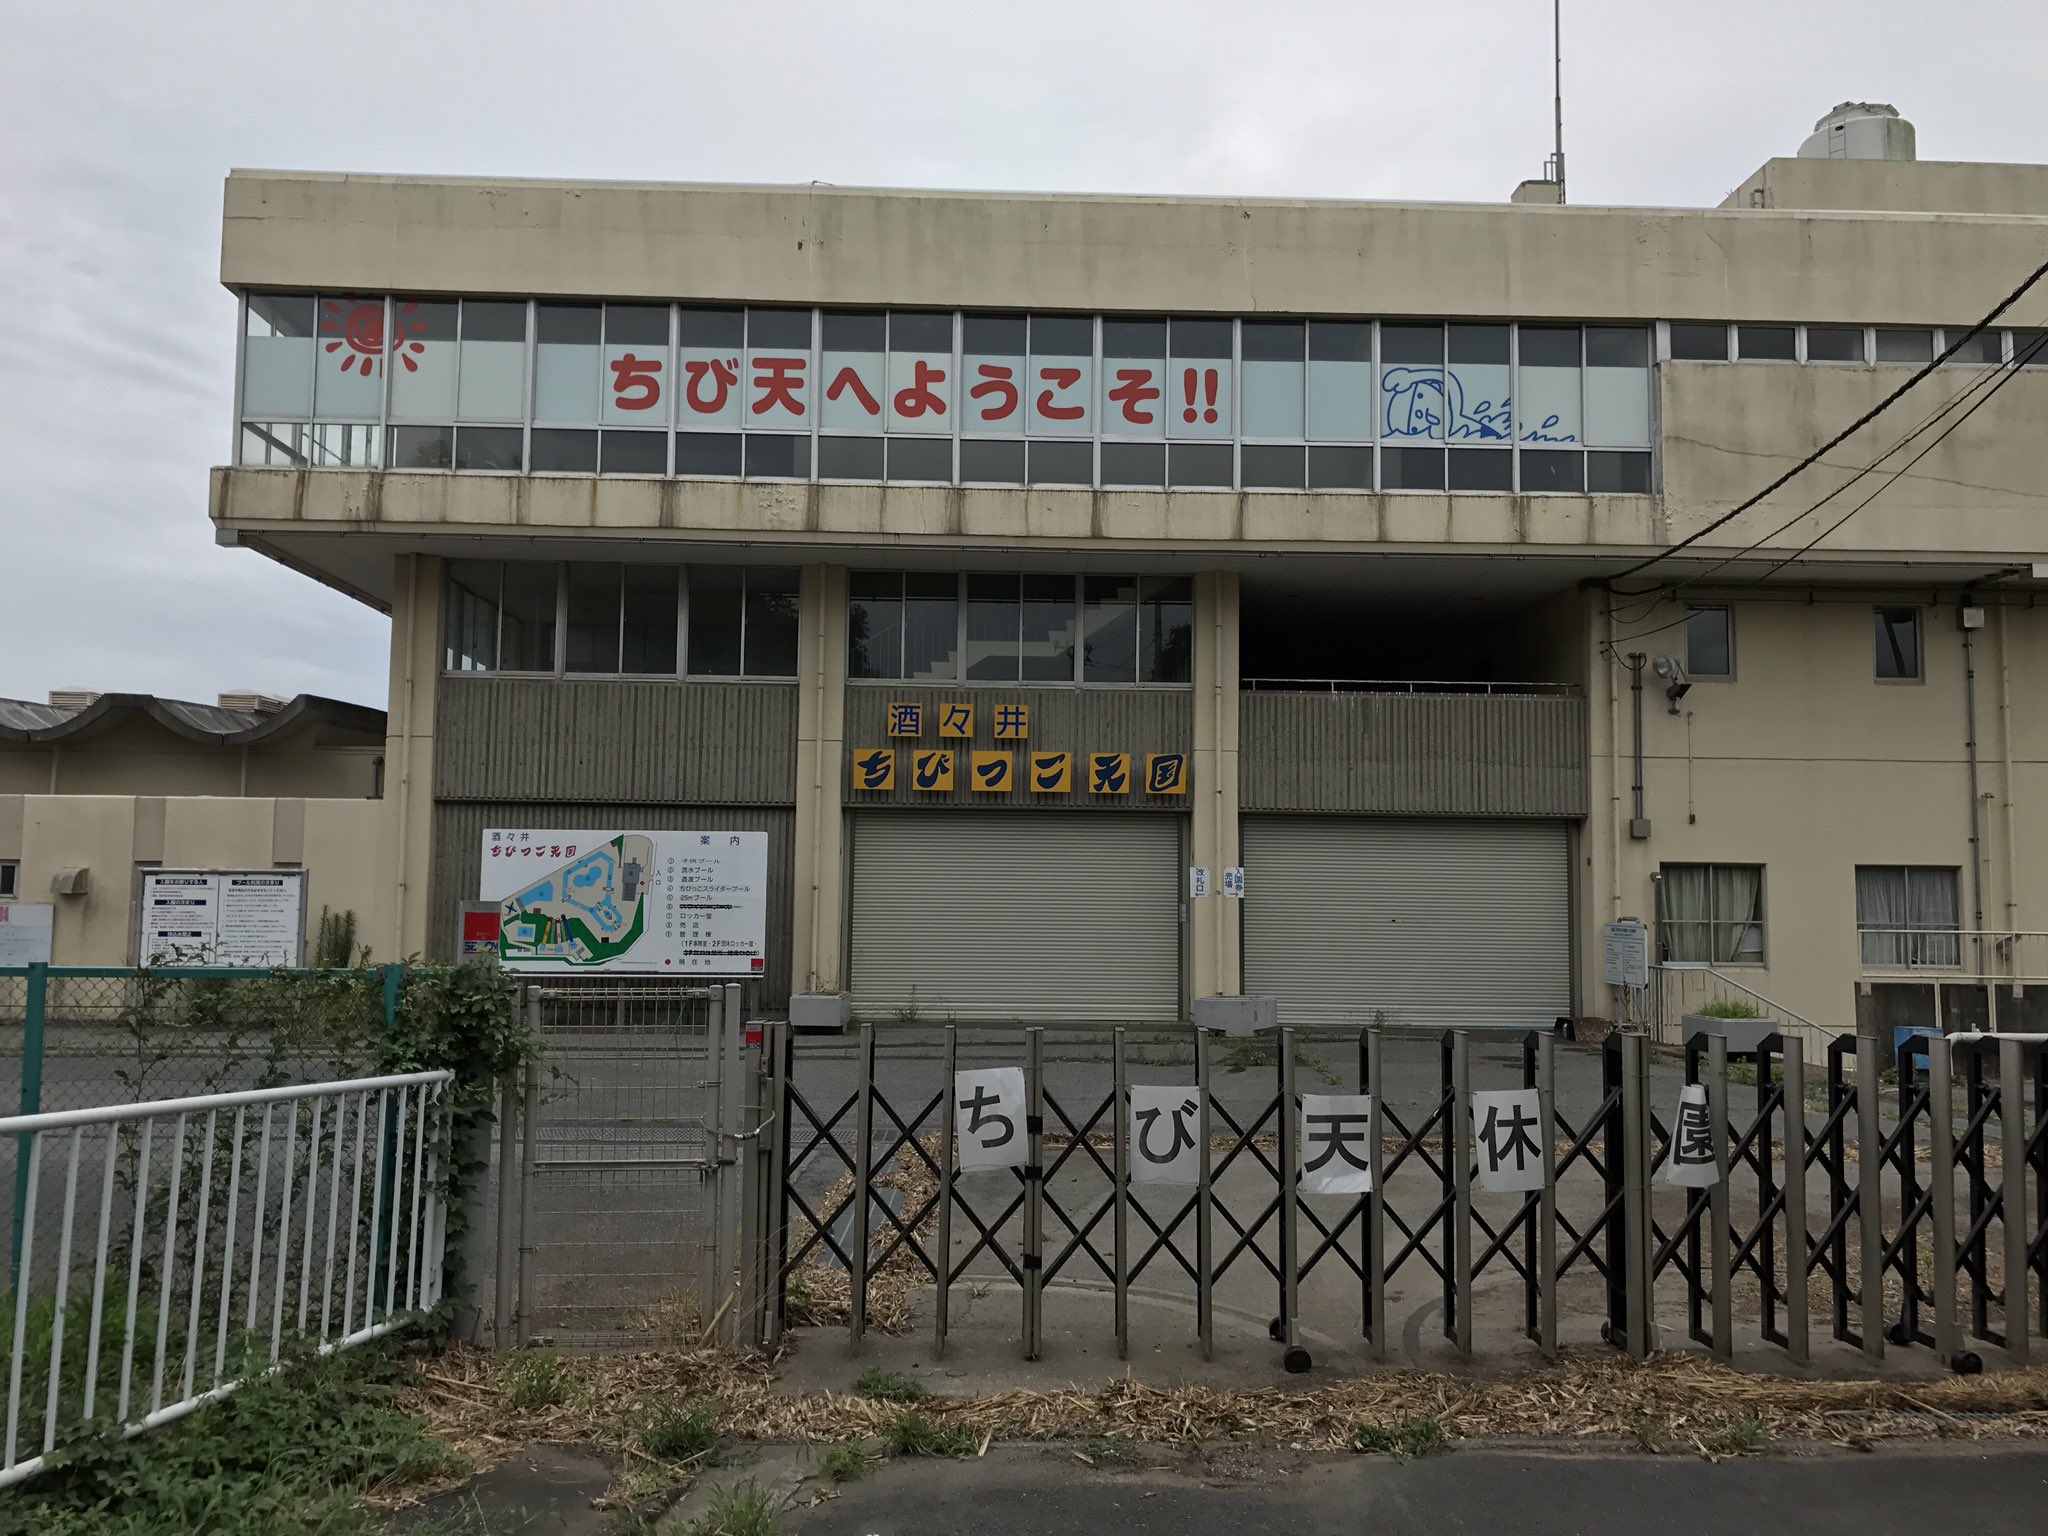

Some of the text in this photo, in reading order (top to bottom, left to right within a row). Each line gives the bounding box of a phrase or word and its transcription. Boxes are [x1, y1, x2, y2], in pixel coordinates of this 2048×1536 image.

[889, 704, 1028, 737] 酒々井
[491, 832, 530, 842] 酒々井
[1195, 868, 1205, 892] 改札口
[678, 958, 711, 966] 現在地
